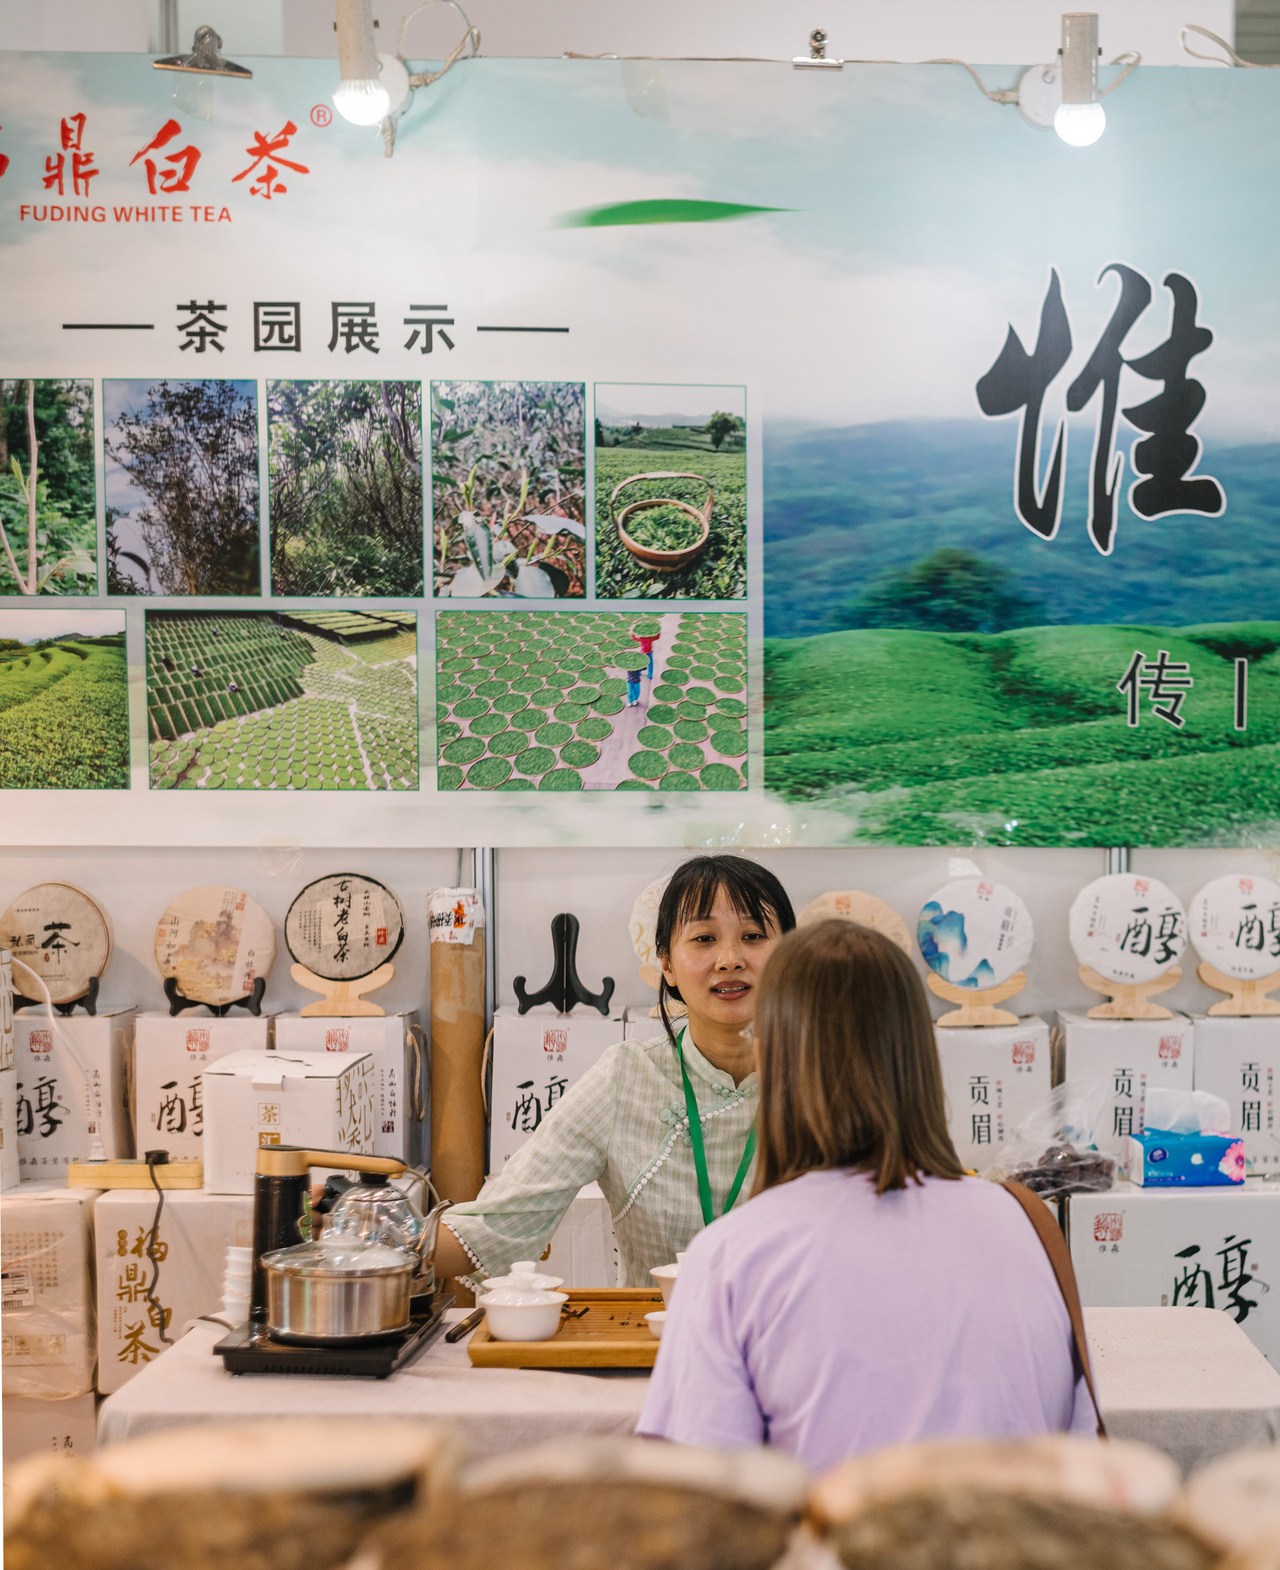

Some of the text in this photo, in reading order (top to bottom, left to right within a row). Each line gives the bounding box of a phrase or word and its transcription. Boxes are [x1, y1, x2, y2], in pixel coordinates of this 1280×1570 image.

[0, 113, 309, 200] 鼎白茶
[20, 206, 232, 222] FUDING WHITE TEA
[177, 300, 455, 354] 茶园展示
[41, 921, 80, 964] 茶
[968, 1075, 990, 1145] 贡眉
[1112, 1068, 1134, 1137] 贡眉
[1240, 1062, 1261, 1131] 贡眉
[116, 1225, 172, 1364] 福鼎白茶
